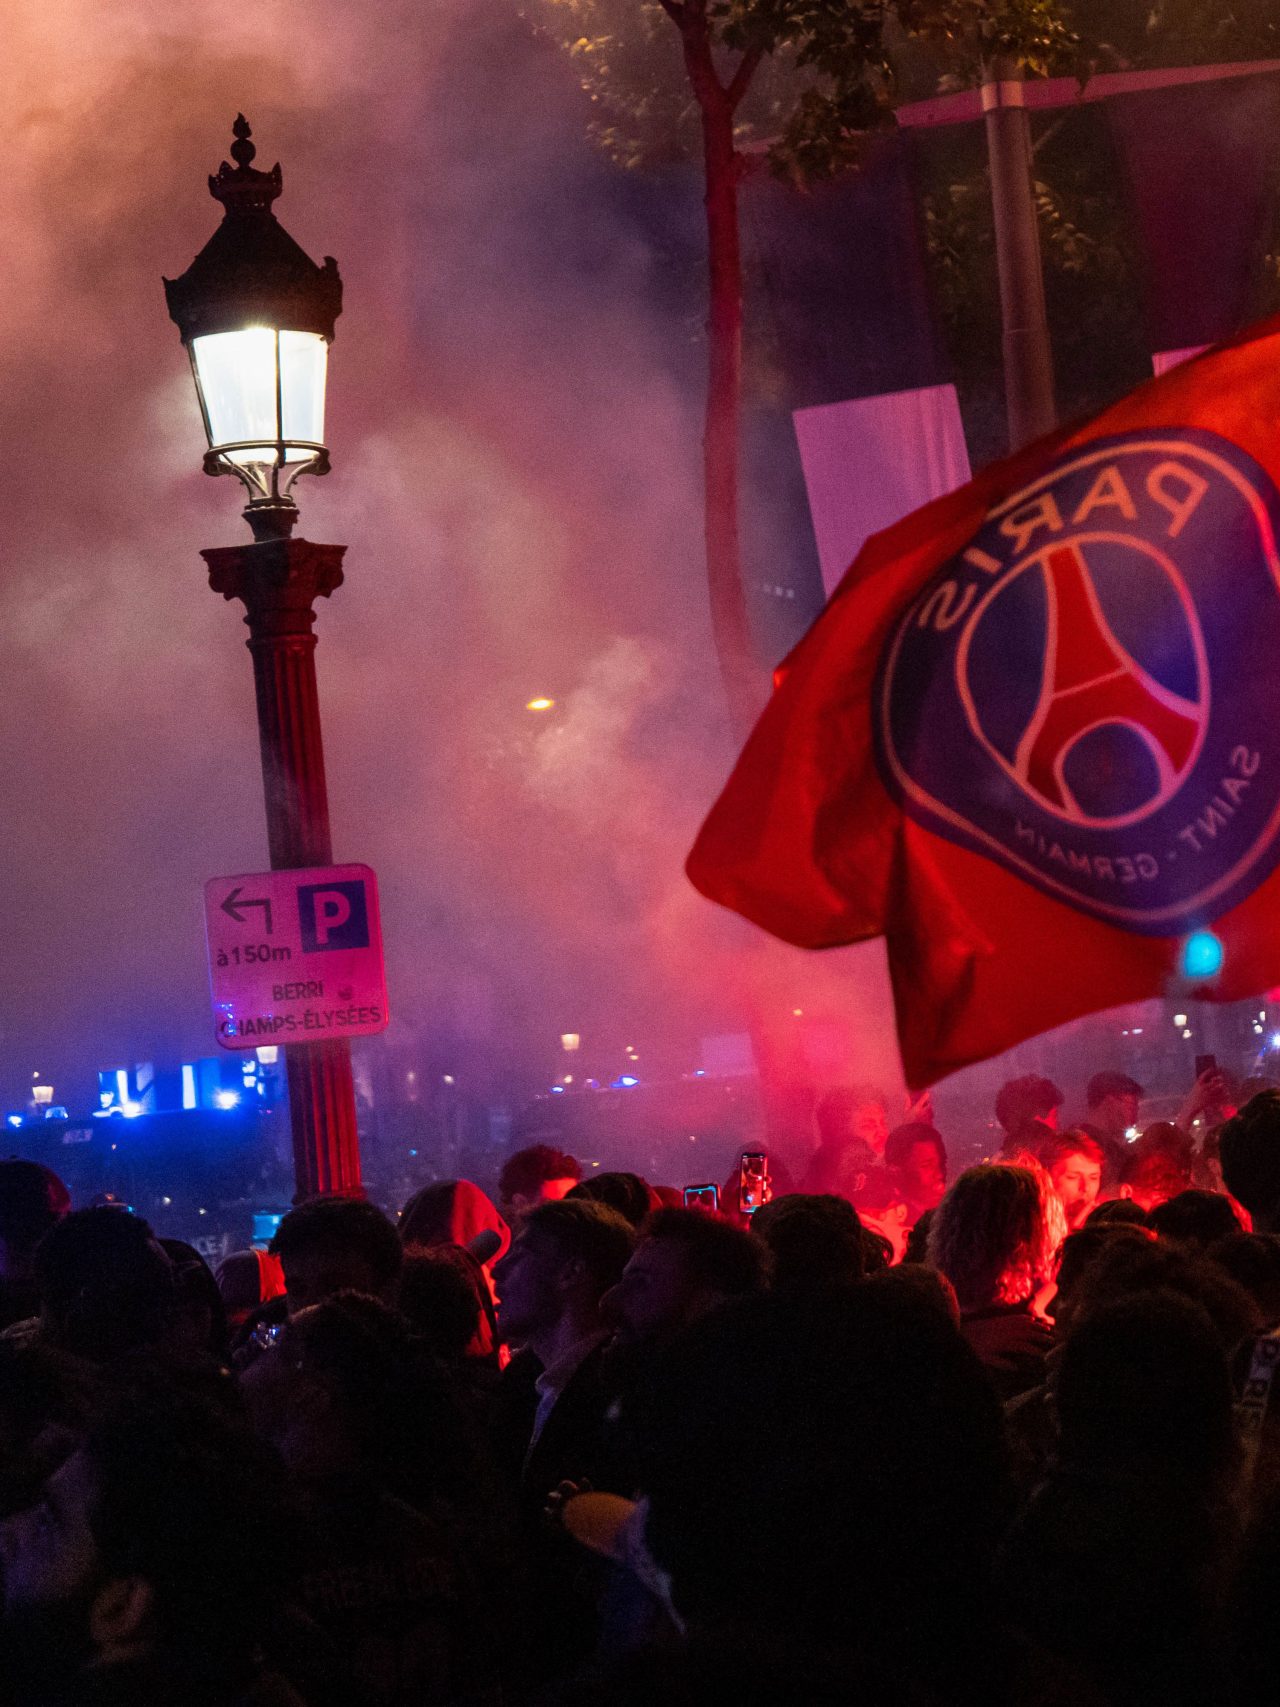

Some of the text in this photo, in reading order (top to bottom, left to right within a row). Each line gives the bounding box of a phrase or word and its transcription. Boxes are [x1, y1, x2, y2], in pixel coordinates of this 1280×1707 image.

[313, 891, 349, 945] P
[272, 981, 324, 1001] BERRI
[1238, 1339, 1280, 1428] PRIS
